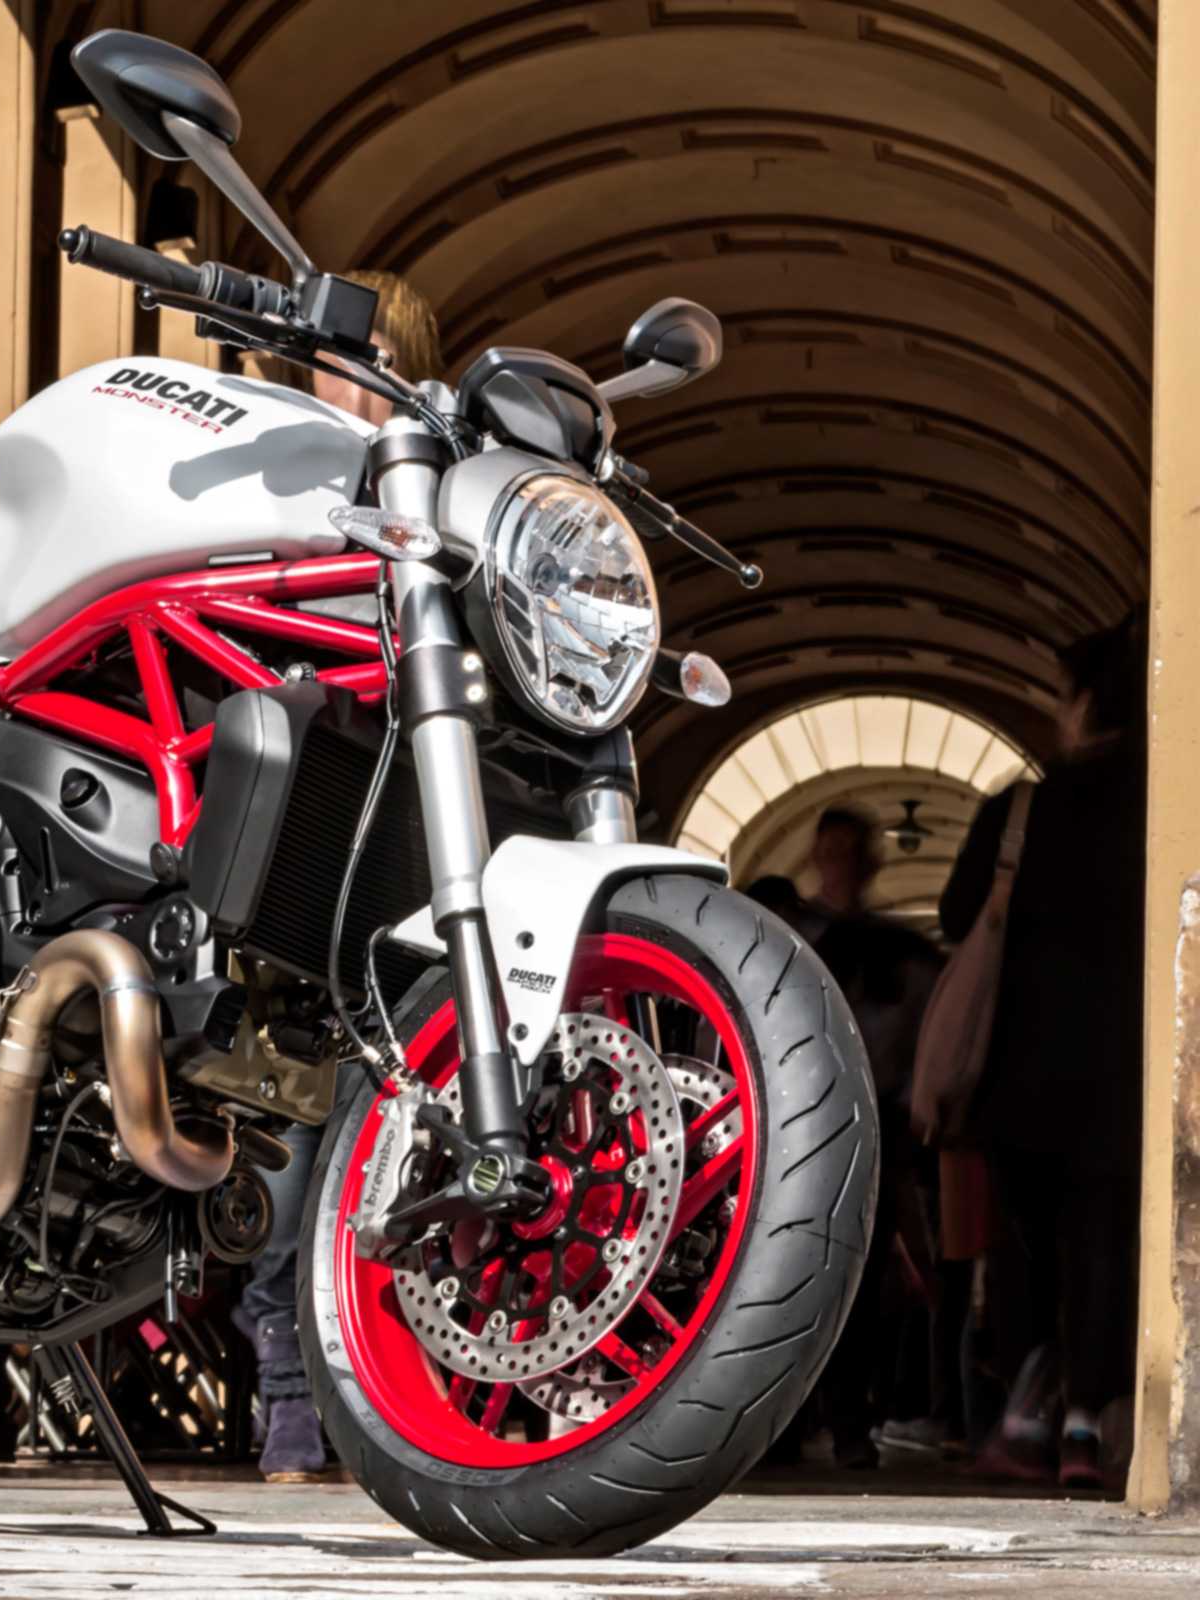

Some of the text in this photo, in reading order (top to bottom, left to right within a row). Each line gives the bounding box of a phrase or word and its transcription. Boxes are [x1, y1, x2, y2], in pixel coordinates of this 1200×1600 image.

[92, 386, 224, 434] MONSTER
[104, 368, 249, 428] DUCATI
[508, 967, 557, 986] DUCATI
[365, 1129, 395, 1206] brembo
[424, 1461, 507, 1484] ROSSO
